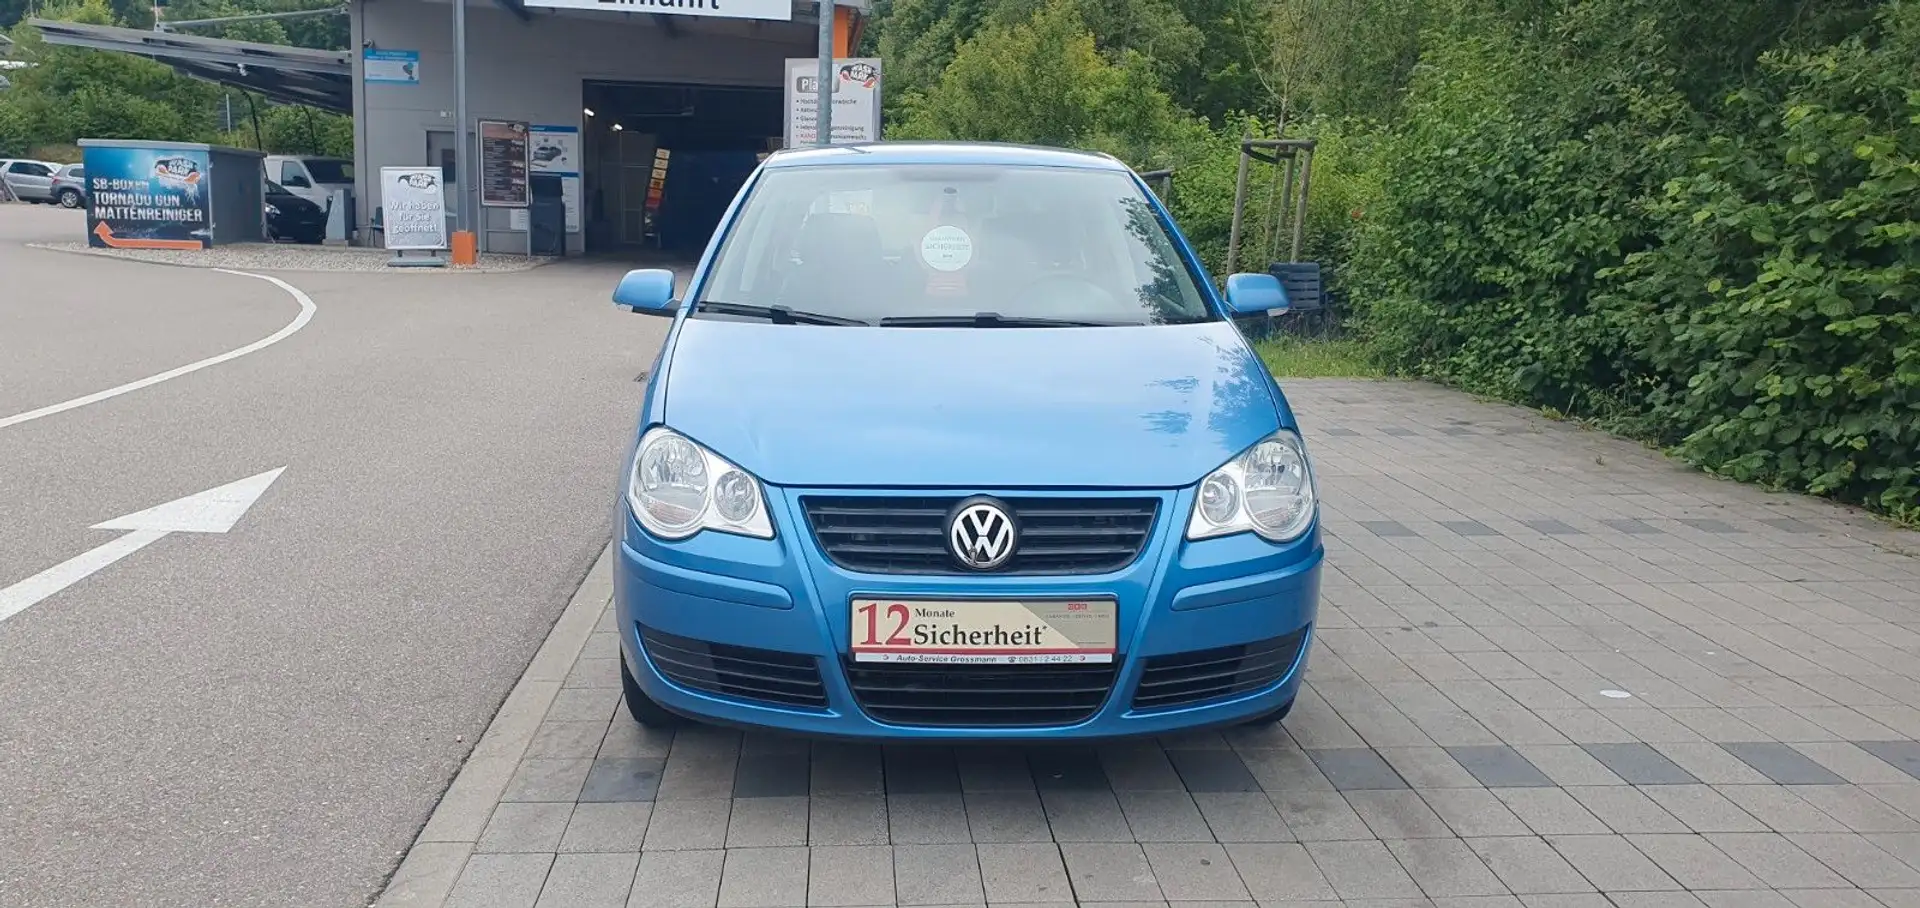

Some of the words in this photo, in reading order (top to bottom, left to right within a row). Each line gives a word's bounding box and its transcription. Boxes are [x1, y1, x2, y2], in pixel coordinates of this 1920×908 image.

[93, 178, 150, 190] SB-BOXEN
[93, 191, 152, 205] TORNADO
[155, 194, 180, 206] GUN
[94, 206, 203, 221] MATTENREINIGER
[915, 608, 955, 618] Monate
[858, 603, 911, 645] 12
[896, 654, 948, 662] Auto-Service
[950, 655, 997, 663] Grossmann
